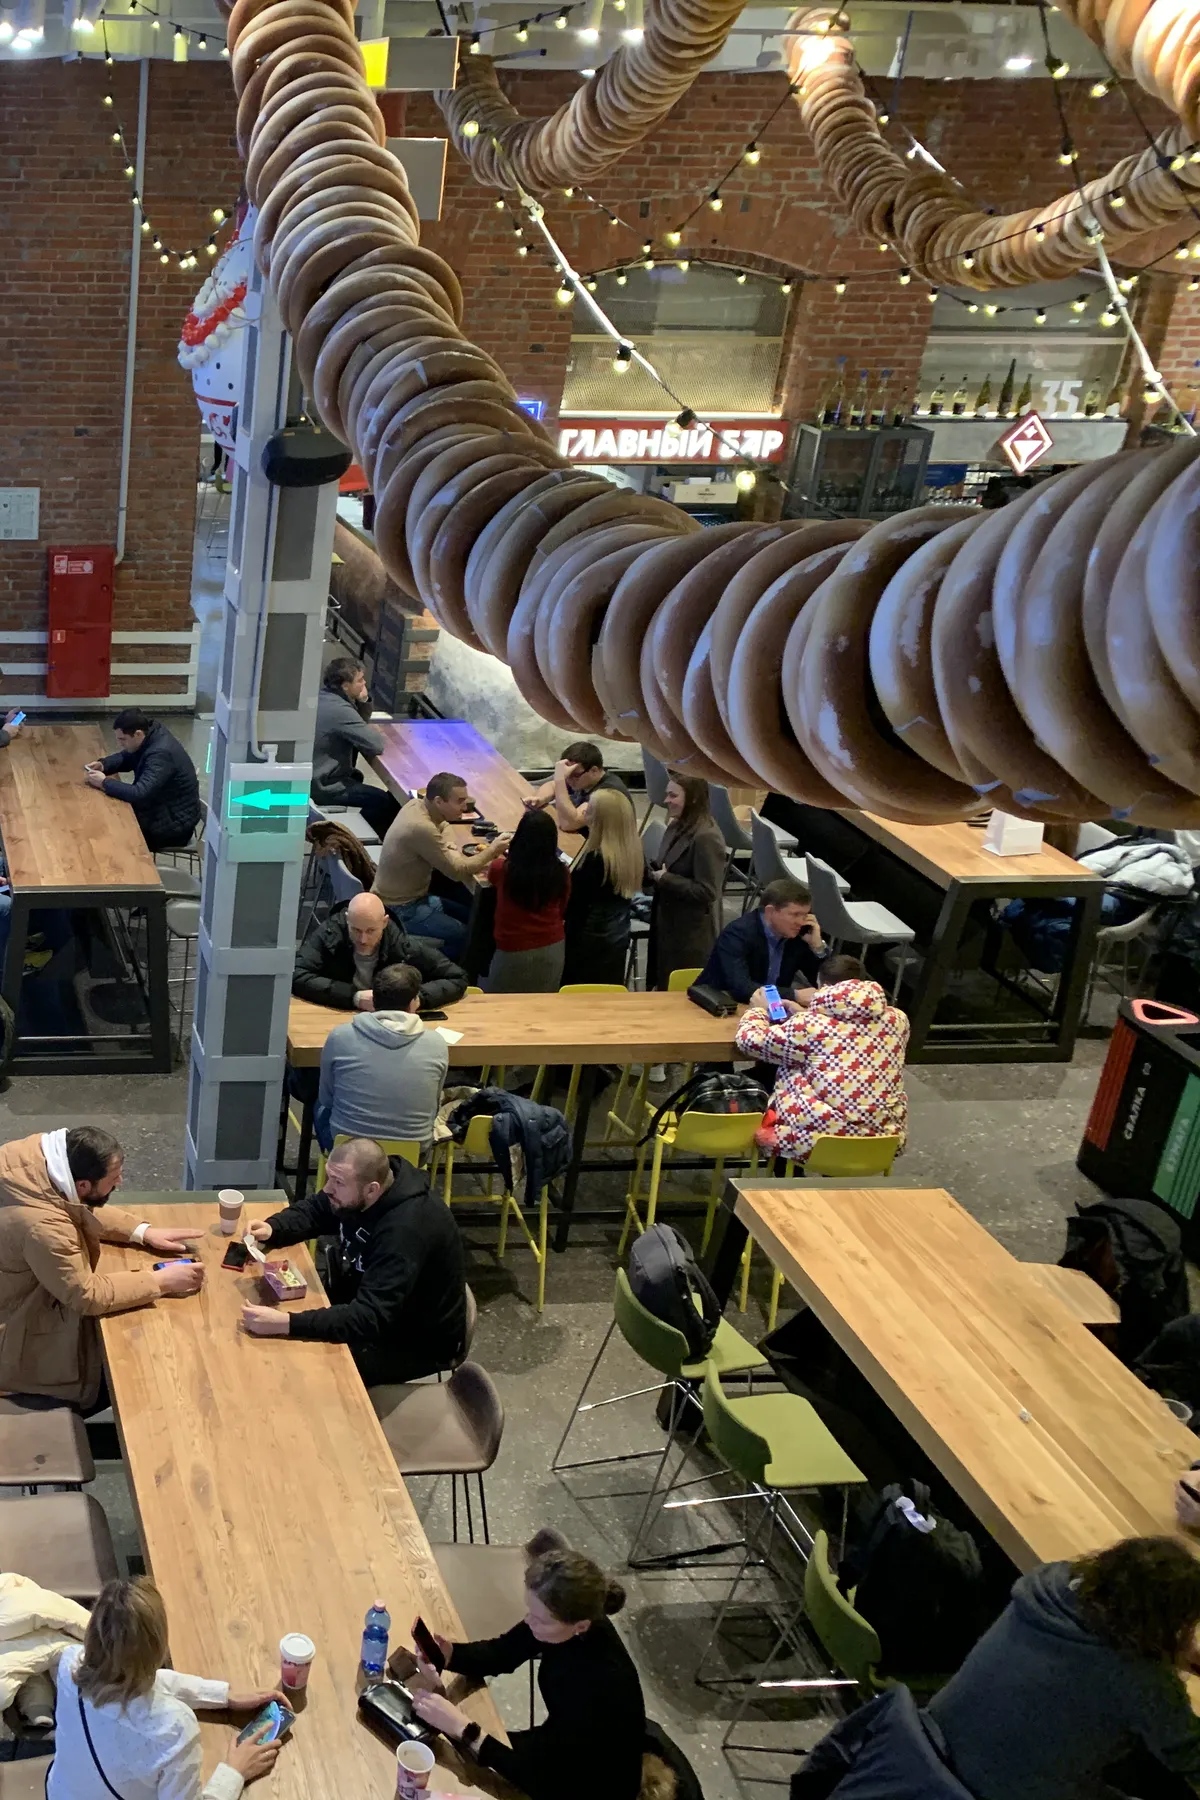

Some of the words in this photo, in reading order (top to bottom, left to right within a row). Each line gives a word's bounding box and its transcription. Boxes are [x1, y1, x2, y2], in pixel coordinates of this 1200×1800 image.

[1039, 380, 1083, 420] 35
[558, 422, 715, 459] ГЛАВНЫЙ
[718, 428, 784, 460] БАР
